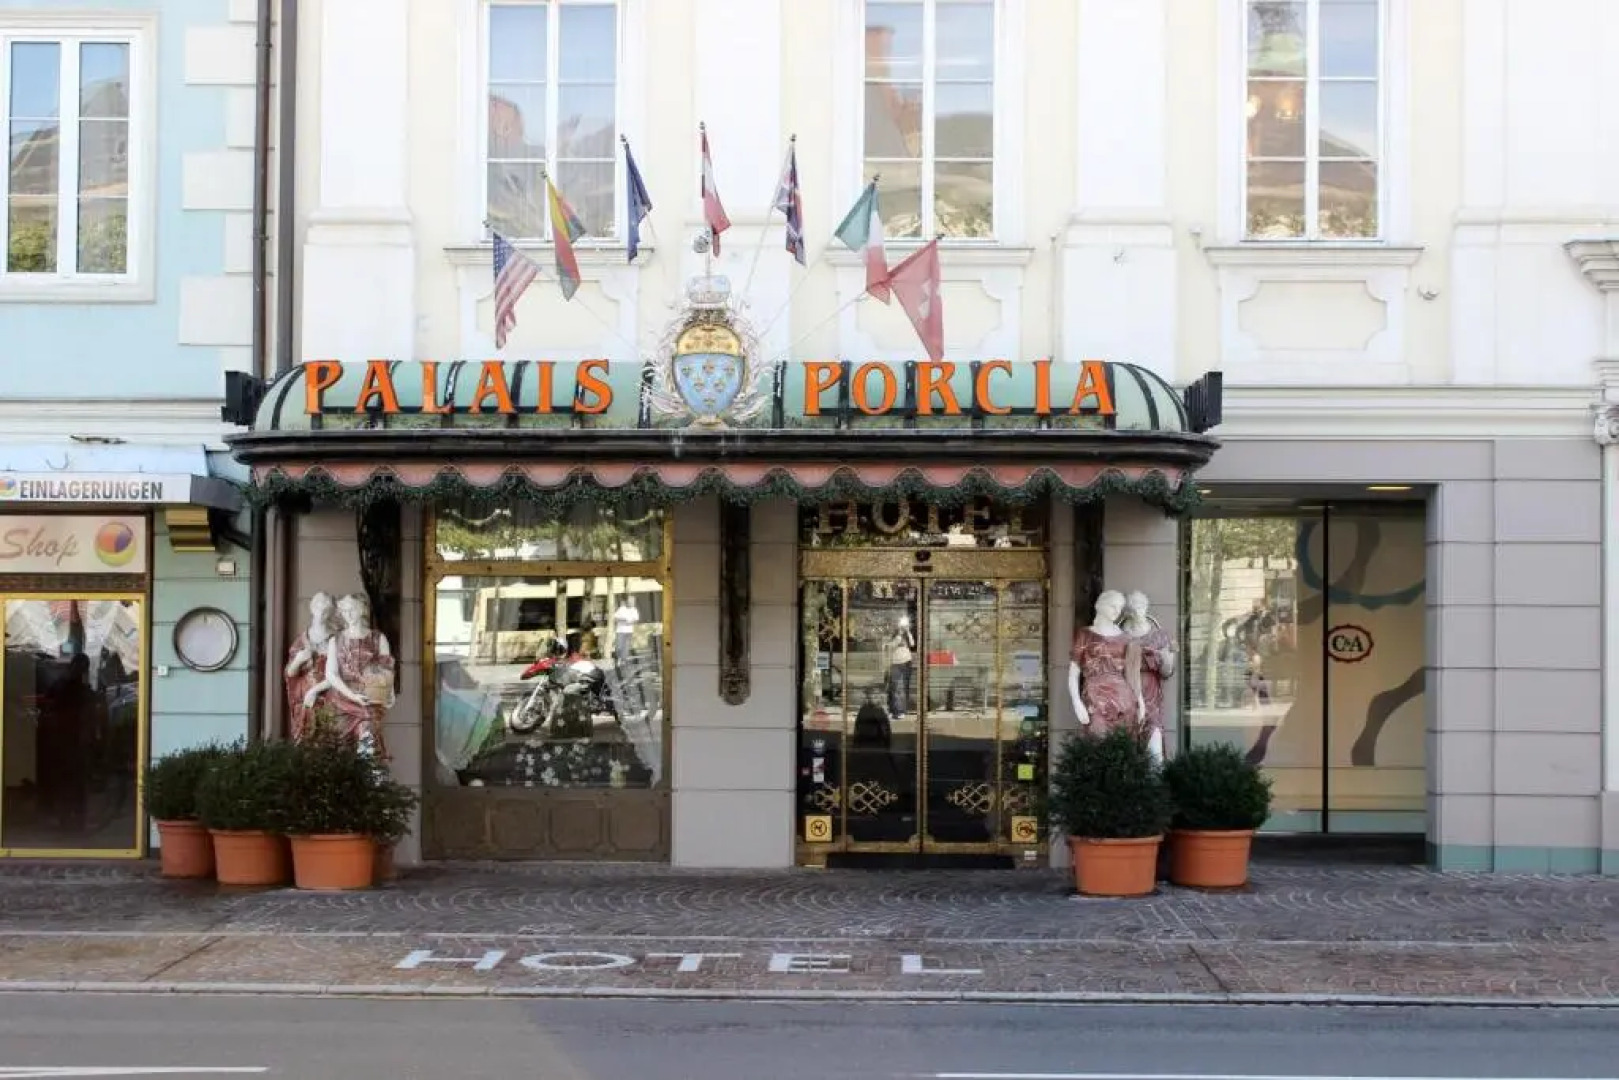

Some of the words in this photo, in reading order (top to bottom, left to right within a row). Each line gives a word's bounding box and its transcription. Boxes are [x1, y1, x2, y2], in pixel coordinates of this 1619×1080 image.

[304, 359, 614, 415] PALAIS
[803, 359, 1116, 416] PORCIA
[20, 480, 163, 500] EINLAGERUNGEN
[0, 526, 79, 566] Shop
[394, 949, 982, 974] HOTEL
